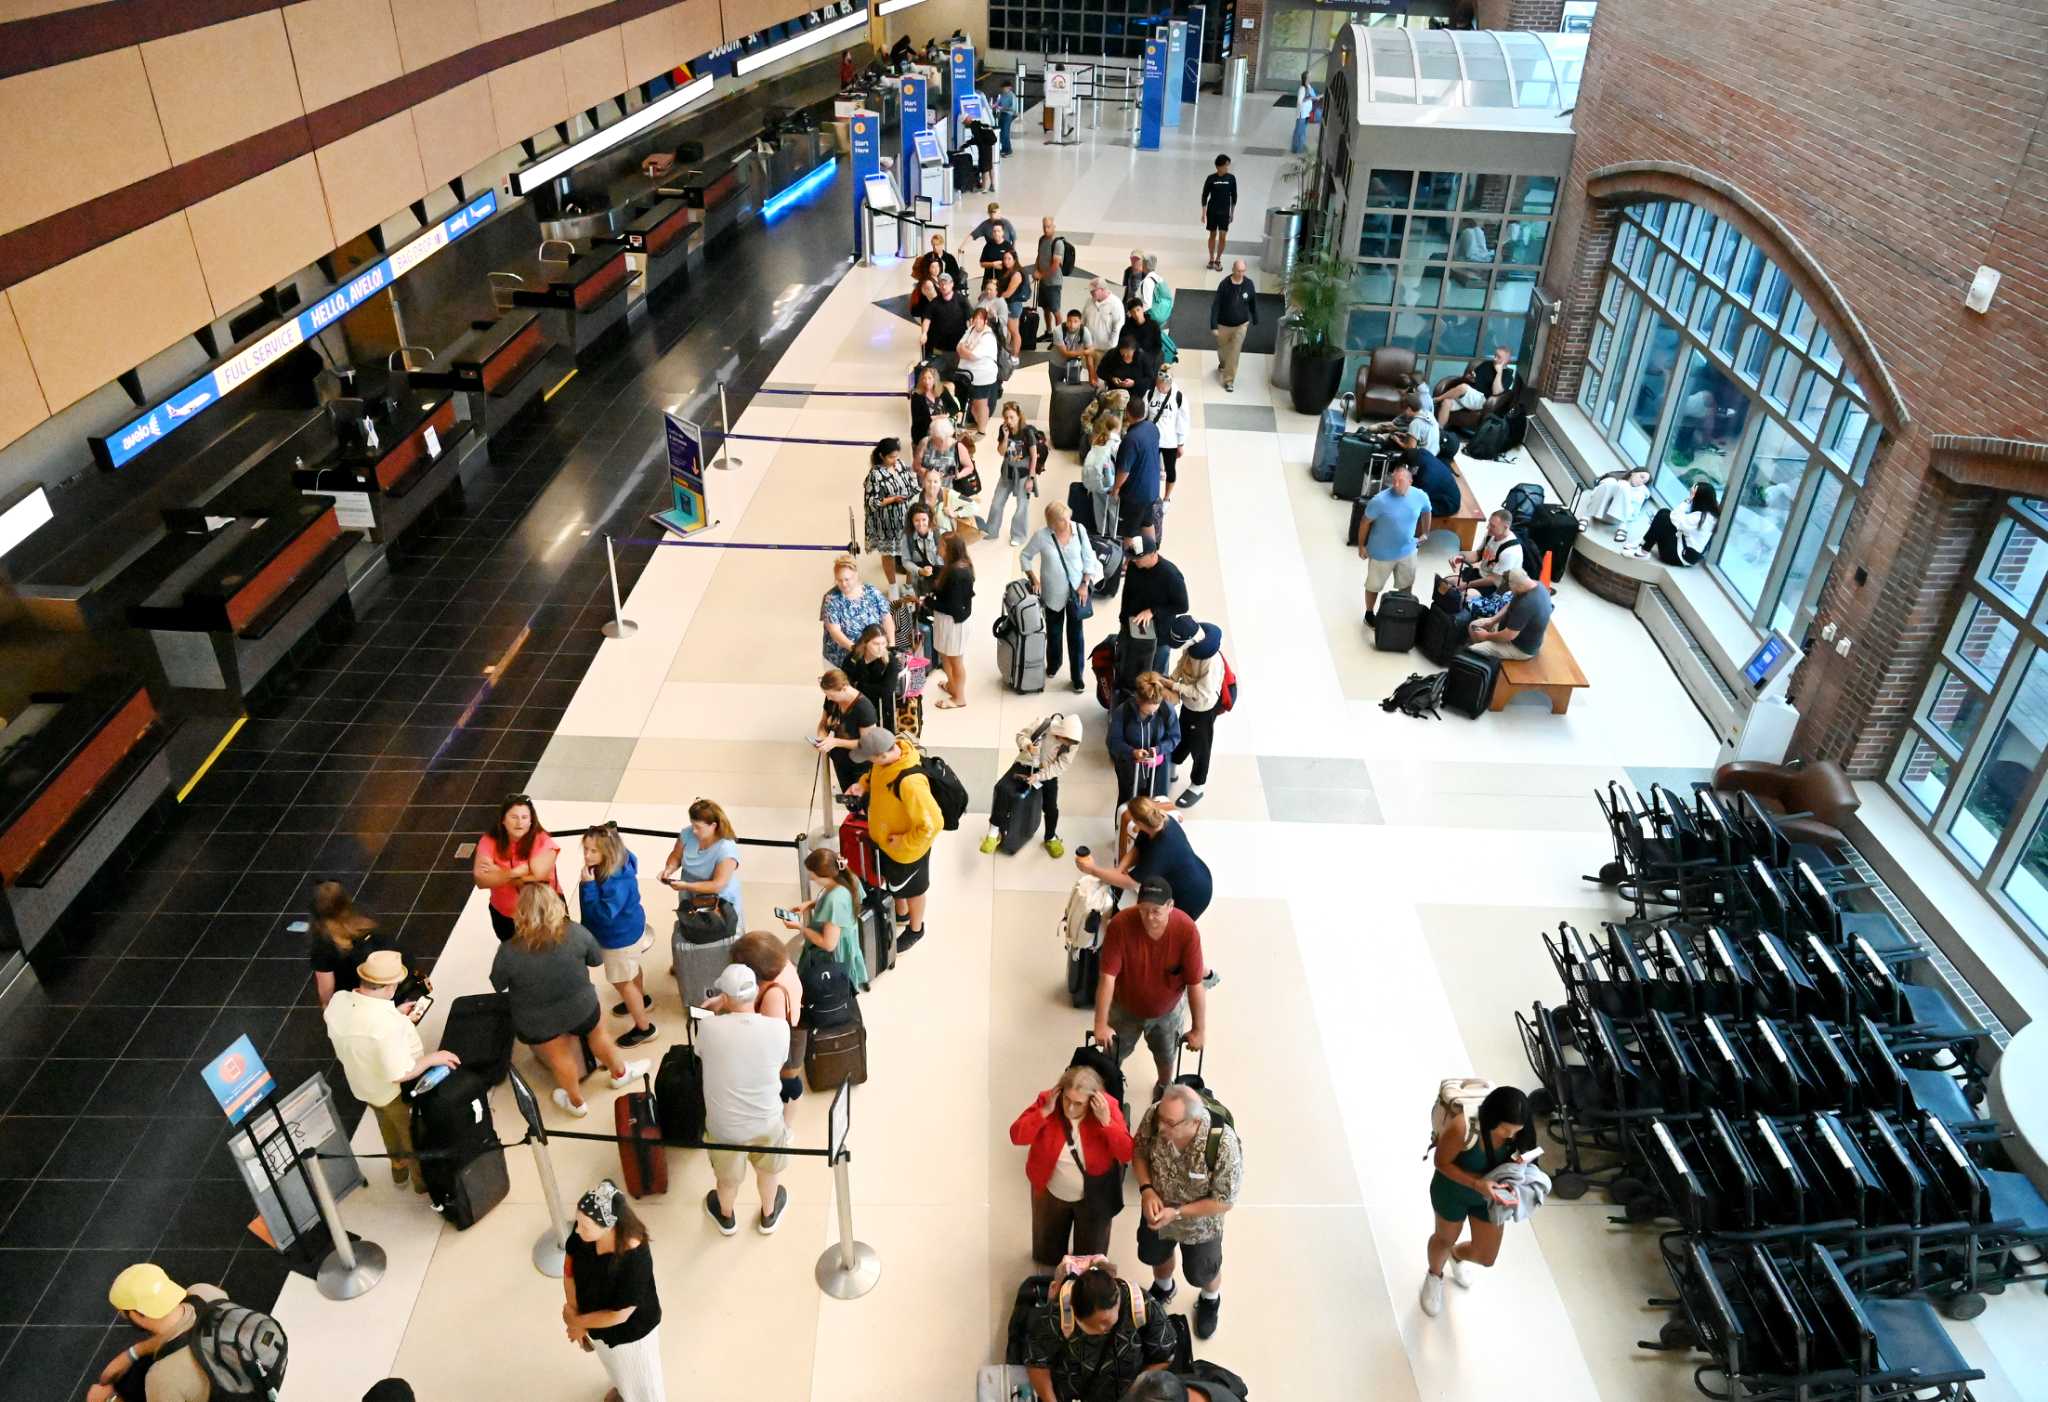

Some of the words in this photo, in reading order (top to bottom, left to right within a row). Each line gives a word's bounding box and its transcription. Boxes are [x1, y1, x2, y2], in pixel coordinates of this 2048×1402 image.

[310, 293, 350, 329] HELLO,
[350, 265, 384, 303] AVELO!
[224, 358, 252, 385] FULL
[252, 327, 295, 367] SERVICE
[122, 422, 151, 450] avelo
